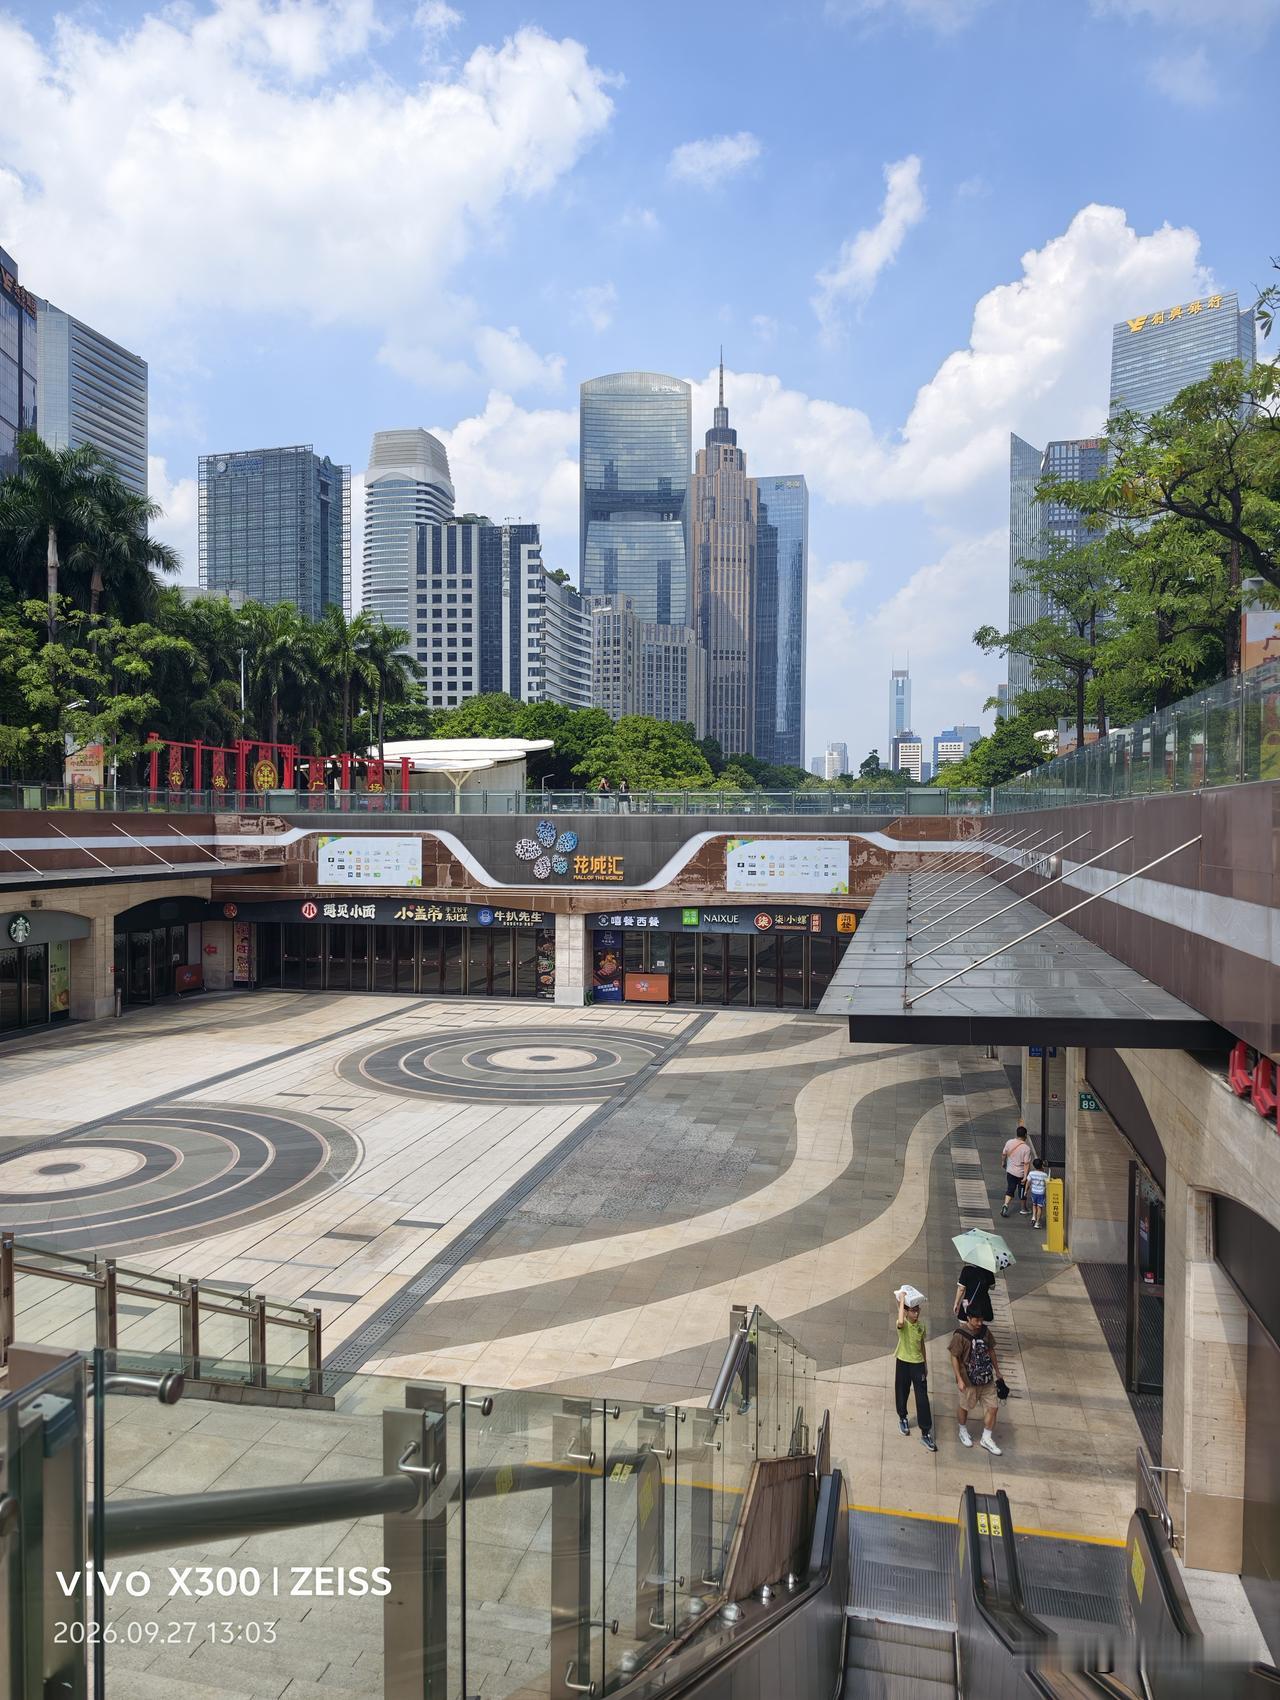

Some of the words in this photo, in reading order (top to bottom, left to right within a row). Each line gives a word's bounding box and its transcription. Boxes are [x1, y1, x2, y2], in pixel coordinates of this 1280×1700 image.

[171, 771, 181, 785] 花
[573, 855, 624, 875] 花城汇
[323, 903, 376, 919] 遇见小面
[494, 911, 542, 922] 牛扒先生
[703, 914, 739, 923] NAIXUE
[1082, 1100, 1096, 1110] 89
